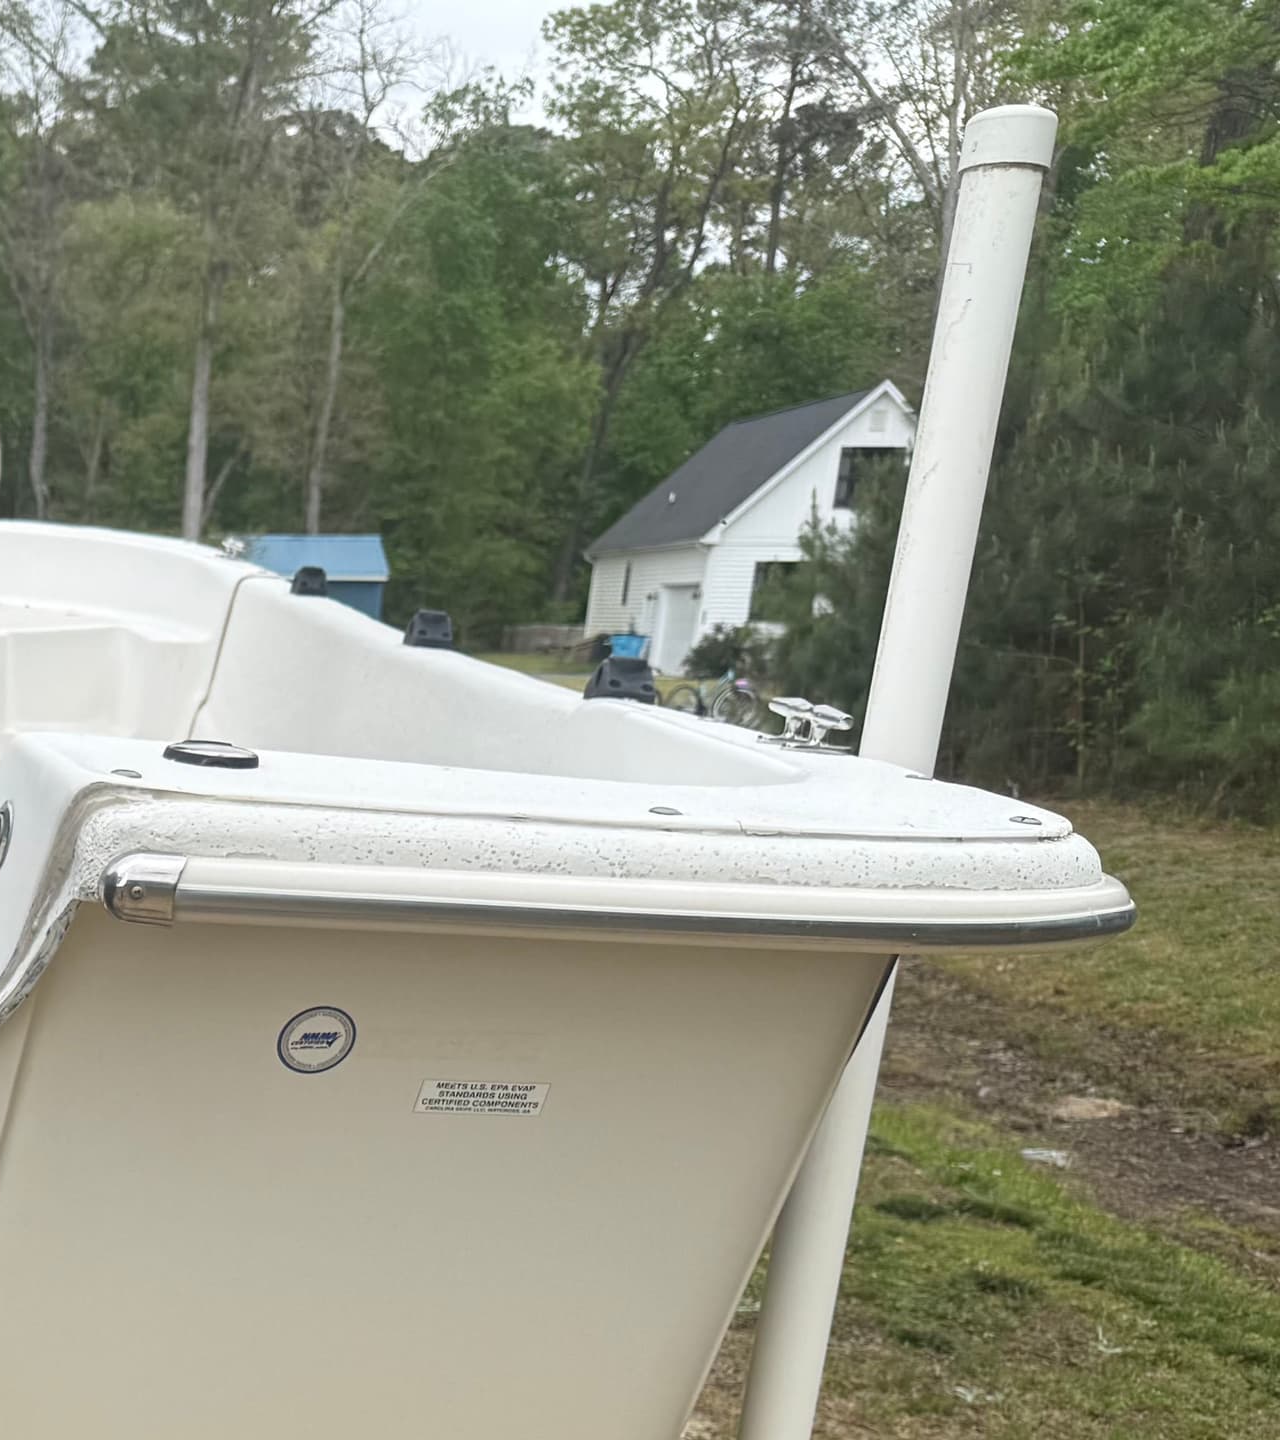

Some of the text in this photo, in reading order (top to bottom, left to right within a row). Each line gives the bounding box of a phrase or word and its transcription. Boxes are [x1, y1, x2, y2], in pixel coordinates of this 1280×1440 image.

[436, 1082, 467, 1090] MEETS
[438, 1090, 528, 1100] STANDARDS USING
[421, 1098, 539, 1109] CERTIFIED COMPONENTS
